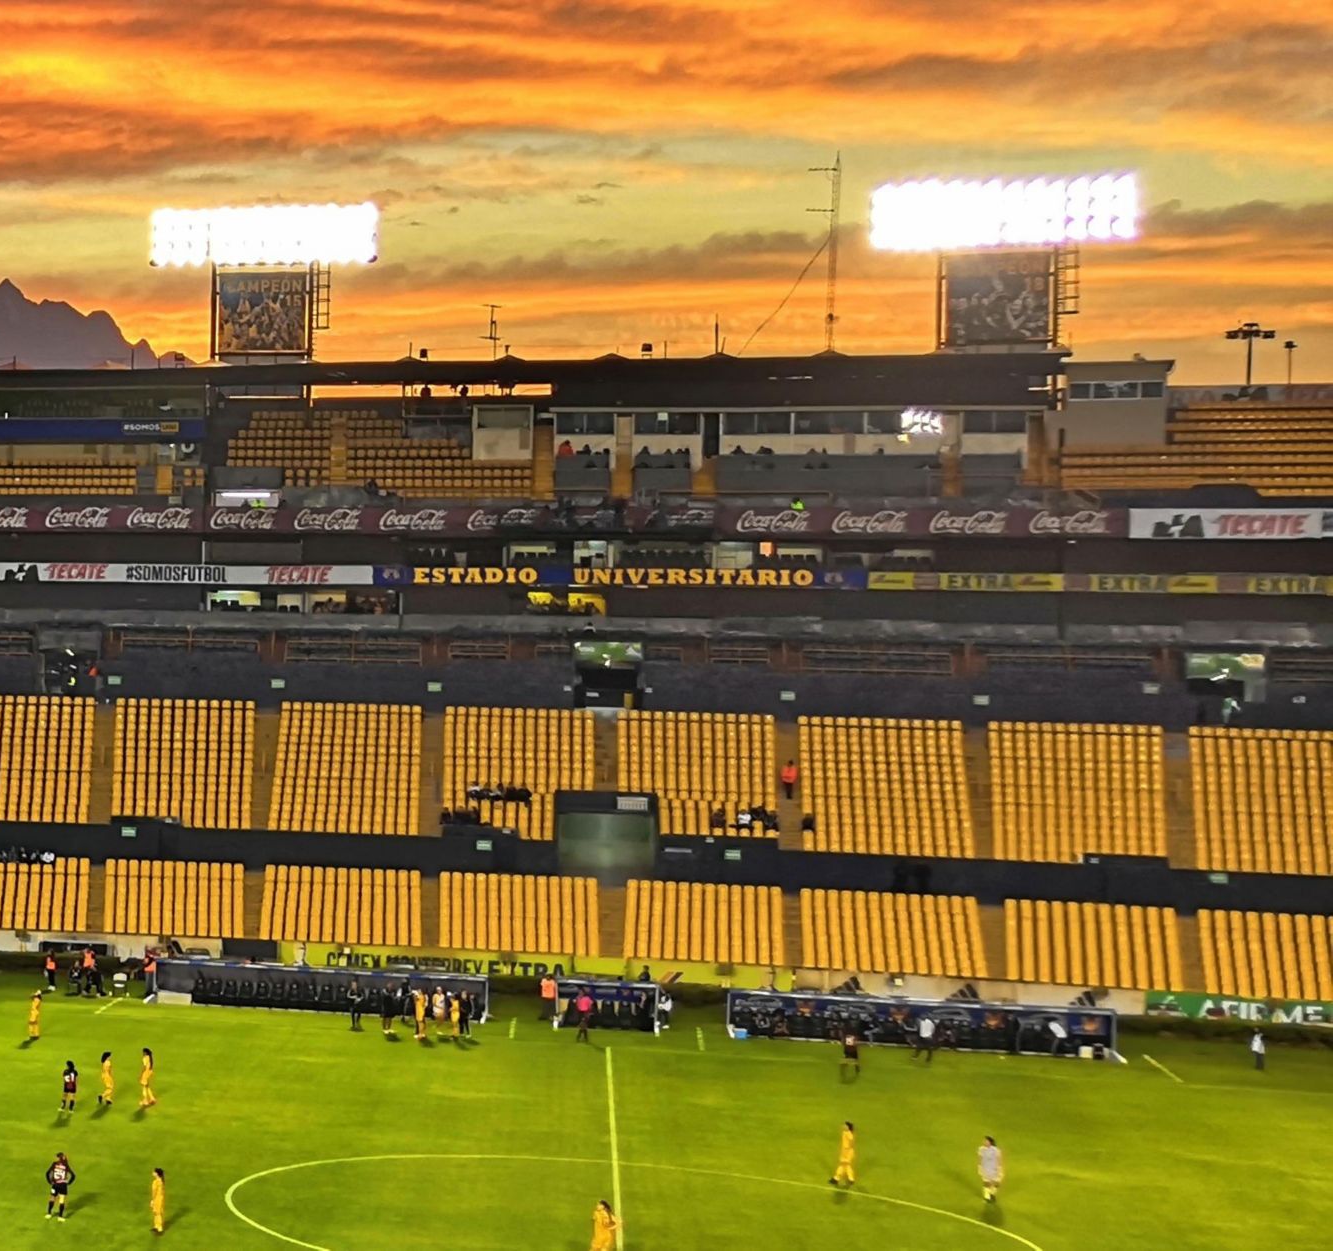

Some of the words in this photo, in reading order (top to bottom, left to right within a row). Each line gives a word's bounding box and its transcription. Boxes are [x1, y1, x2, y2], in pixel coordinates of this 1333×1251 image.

[45, 506, 111, 529] Coca-Cola
[127, 507, 193, 530] Coca-Cola
[210, 507, 277, 531] Coca-Cola
[294, 508, 362, 531] Coca-Cola
[379, 508, 449, 531] Coca-Cola
[736, 510, 810, 533] Coca-Cola
[832, 511, 908, 533] Coca-Cola
[930, 511, 1007, 534] Coca-Cola
[1213, 514, 1311, 536] TECATE
[44, 564, 109, 580] TECATE
[126, 564, 227, 583] #SOMOSFUTBOL
[266, 567, 333, 584] TECATE
[413, 567, 538, 584] ESTADIO
[573, 568, 815, 586] UNIVERSITARIO
